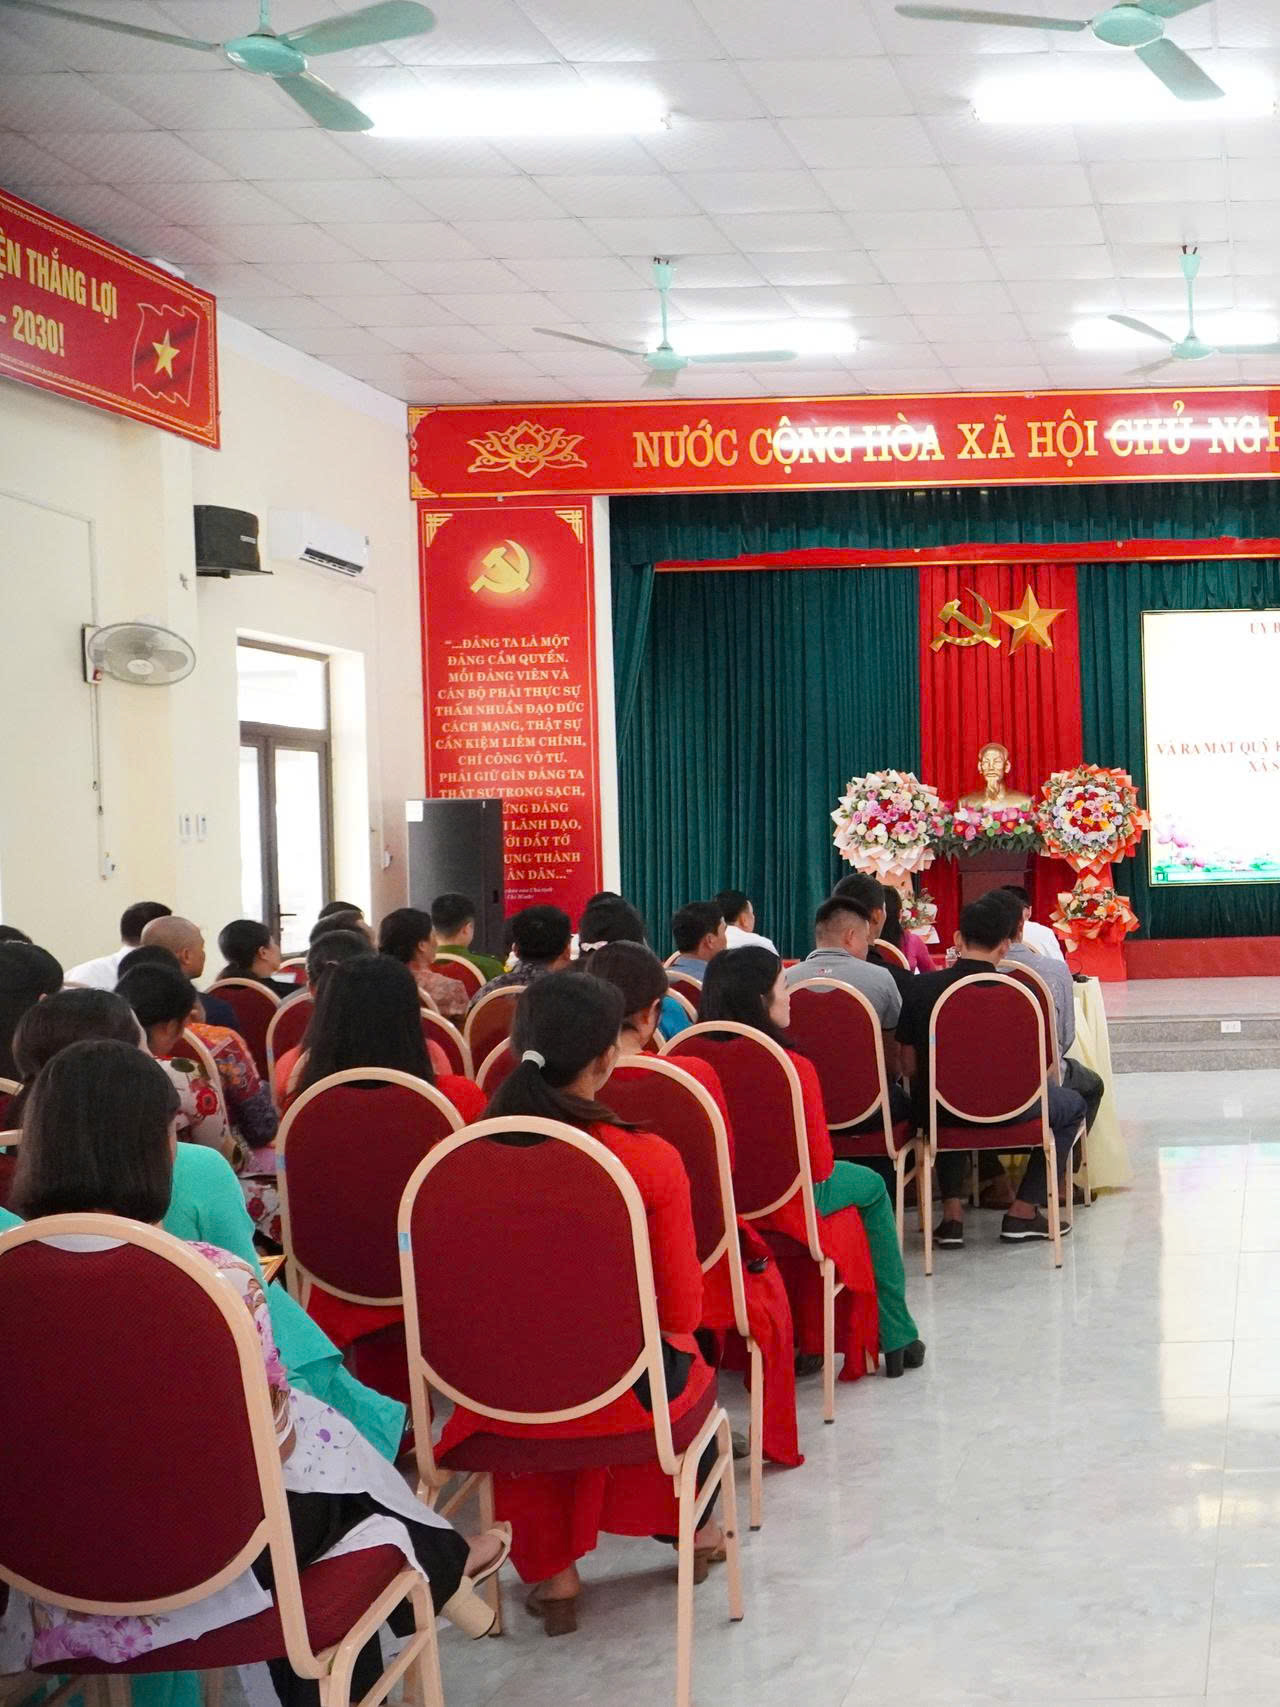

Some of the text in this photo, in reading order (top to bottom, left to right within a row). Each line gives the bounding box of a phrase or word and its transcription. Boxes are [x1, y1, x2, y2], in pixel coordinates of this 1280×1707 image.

[26, 247, 87, 307] THẮNG
[91, 277, 118, 324] LỢI
[12, 304, 65, 358] 2030!
[633, 419, 738, 468] NƯỚC
[750, 415, 852, 474] CỘNG
[863, 412, 945, 462] HÒA
[957, 413, 1015, 460] XÃ
[1027, 408, 1099, 468] HỘI
[1108, 400, 1193, 457] CHỦ
[503, 637, 519, 647] TA
[522, 635, 538, 647] LÀ
[541, 634, 570, 648] MỘT
[517, 668, 548, 681] VIÊN
[552, 667, 569, 680] VÀ
[468, 686, 486, 700] BỘ
[526, 703, 554, 715] ĐẠO
[556, 701, 584, 714] ĐỨC
[442, 719, 478, 732] CÁCH
[466, 736, 500, 750] KIỆM
[485, 752, 522, 765] CÔNG
[524, 752, 543, 764] VÔ
[567, 769, 585, 780] TA
[499, 786, 543, 798] TRONG
[503, 801, 528, 815] ỨNG
[503, 850, 581, 864] UNG THÀNH
